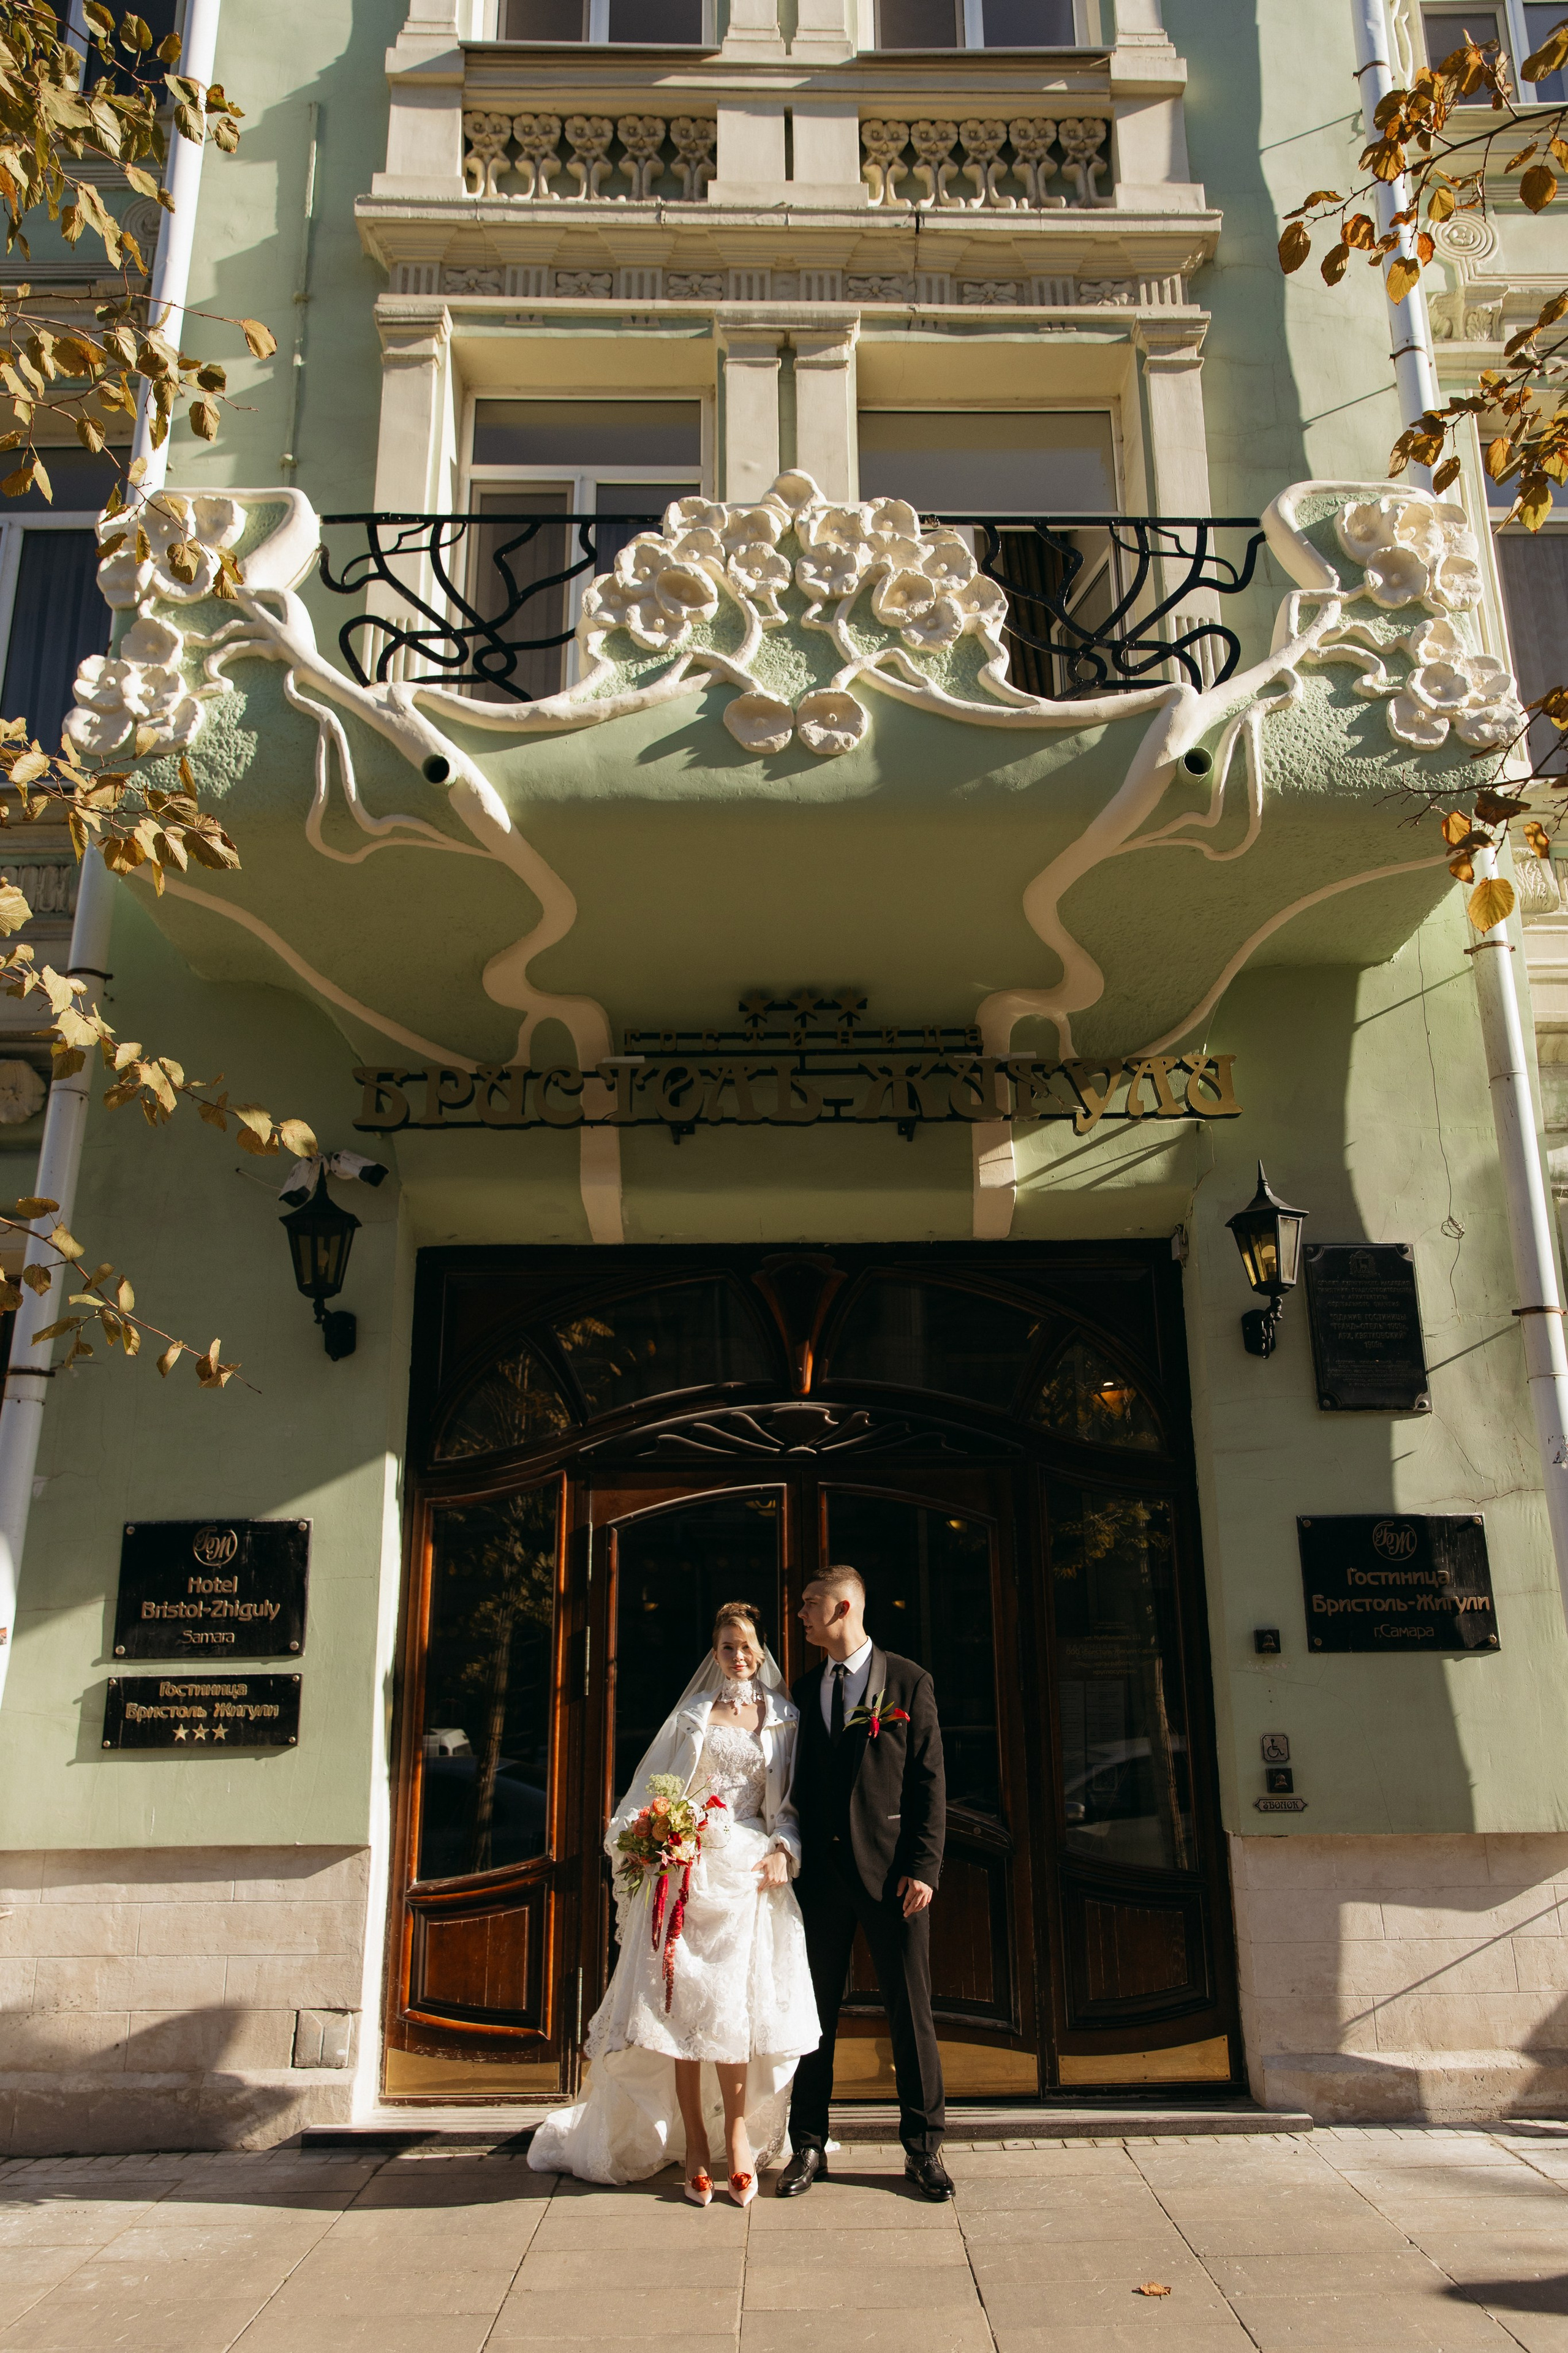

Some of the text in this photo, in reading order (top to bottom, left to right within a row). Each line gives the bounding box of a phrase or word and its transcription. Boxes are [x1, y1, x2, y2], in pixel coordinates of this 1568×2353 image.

[187, 1576, 238, 1594] Hotel
[1346, 1568, 1450, 1588] Гостиница
[141, 1600, 281, 1622] Bristol-Zhiguly
[1312, 1594, 1490, 1616] Бристоль-Жигули
[181, 1630, 235, 1644] Samara
[159, 1682, 247, 1698] Гостиница
[125, 1702, 279, 1722] Бристоль Жигули
